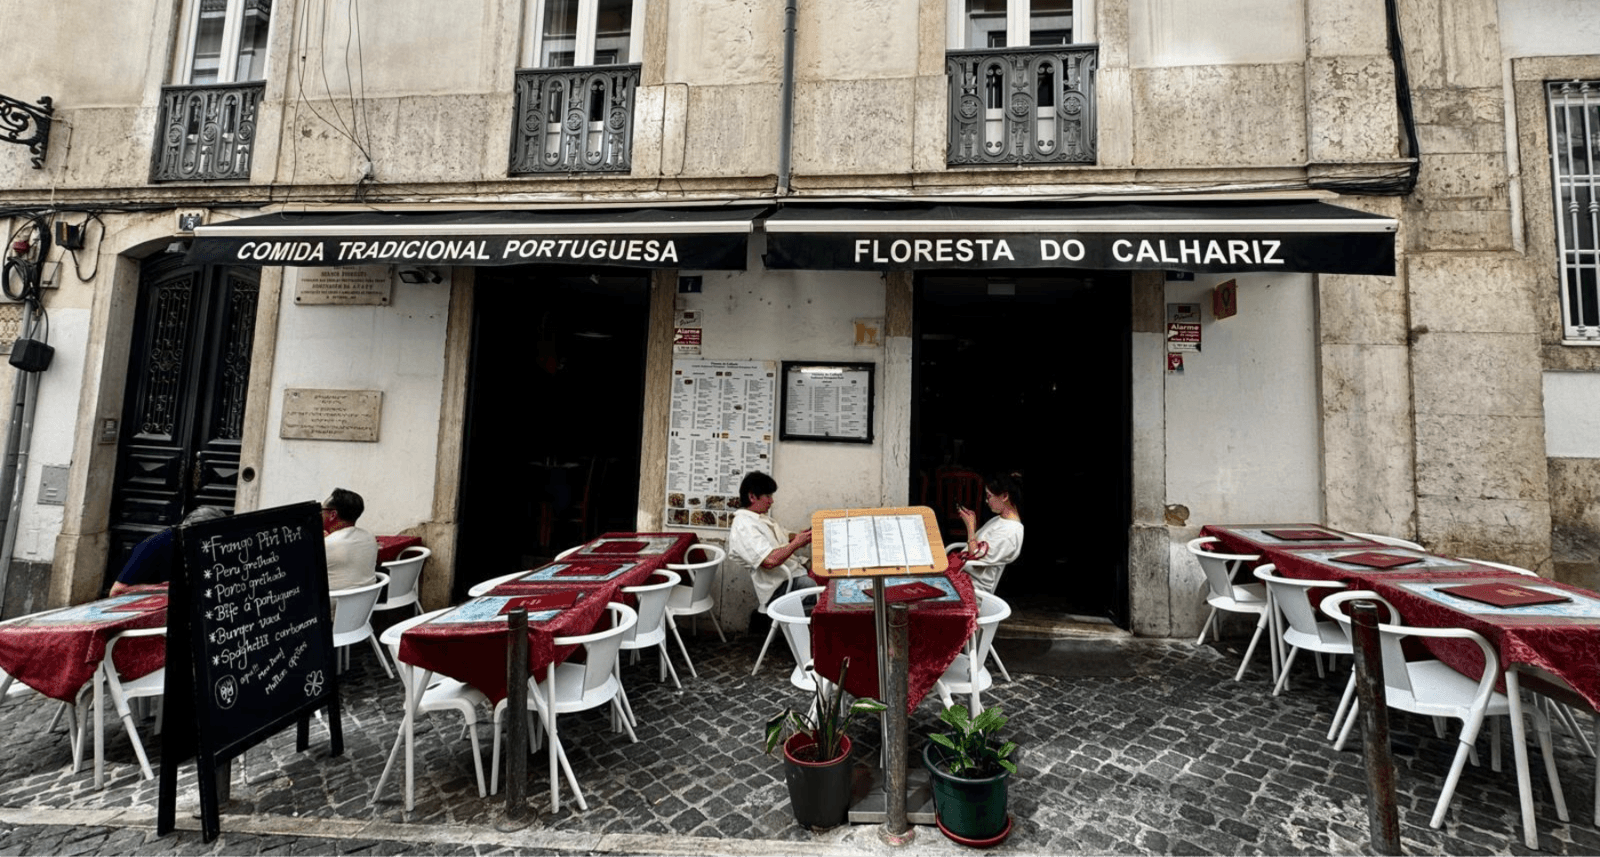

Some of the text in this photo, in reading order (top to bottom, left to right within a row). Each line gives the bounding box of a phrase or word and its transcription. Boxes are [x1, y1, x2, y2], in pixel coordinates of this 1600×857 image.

[187, 217, 195, 230] 5
[237, 239, 679, 263] COMIDA TRADICIONAL PORTUGUESA
[854, 239, 1285, 265] FLORESTA DO CALHARIZ
[210, 525, 302, 564] Frango Piri Piri
[212, 551, 280, 582] Peru grelhado
[214, 566, 287, 604] Porco grelhado
[214, 602, 239, 623] Bife
[253, 586, 300, 617] portuguesa
[215, 613, 281, 648] Burger vaca
[220, 616, 318, 671] Spaghetti carbonara
